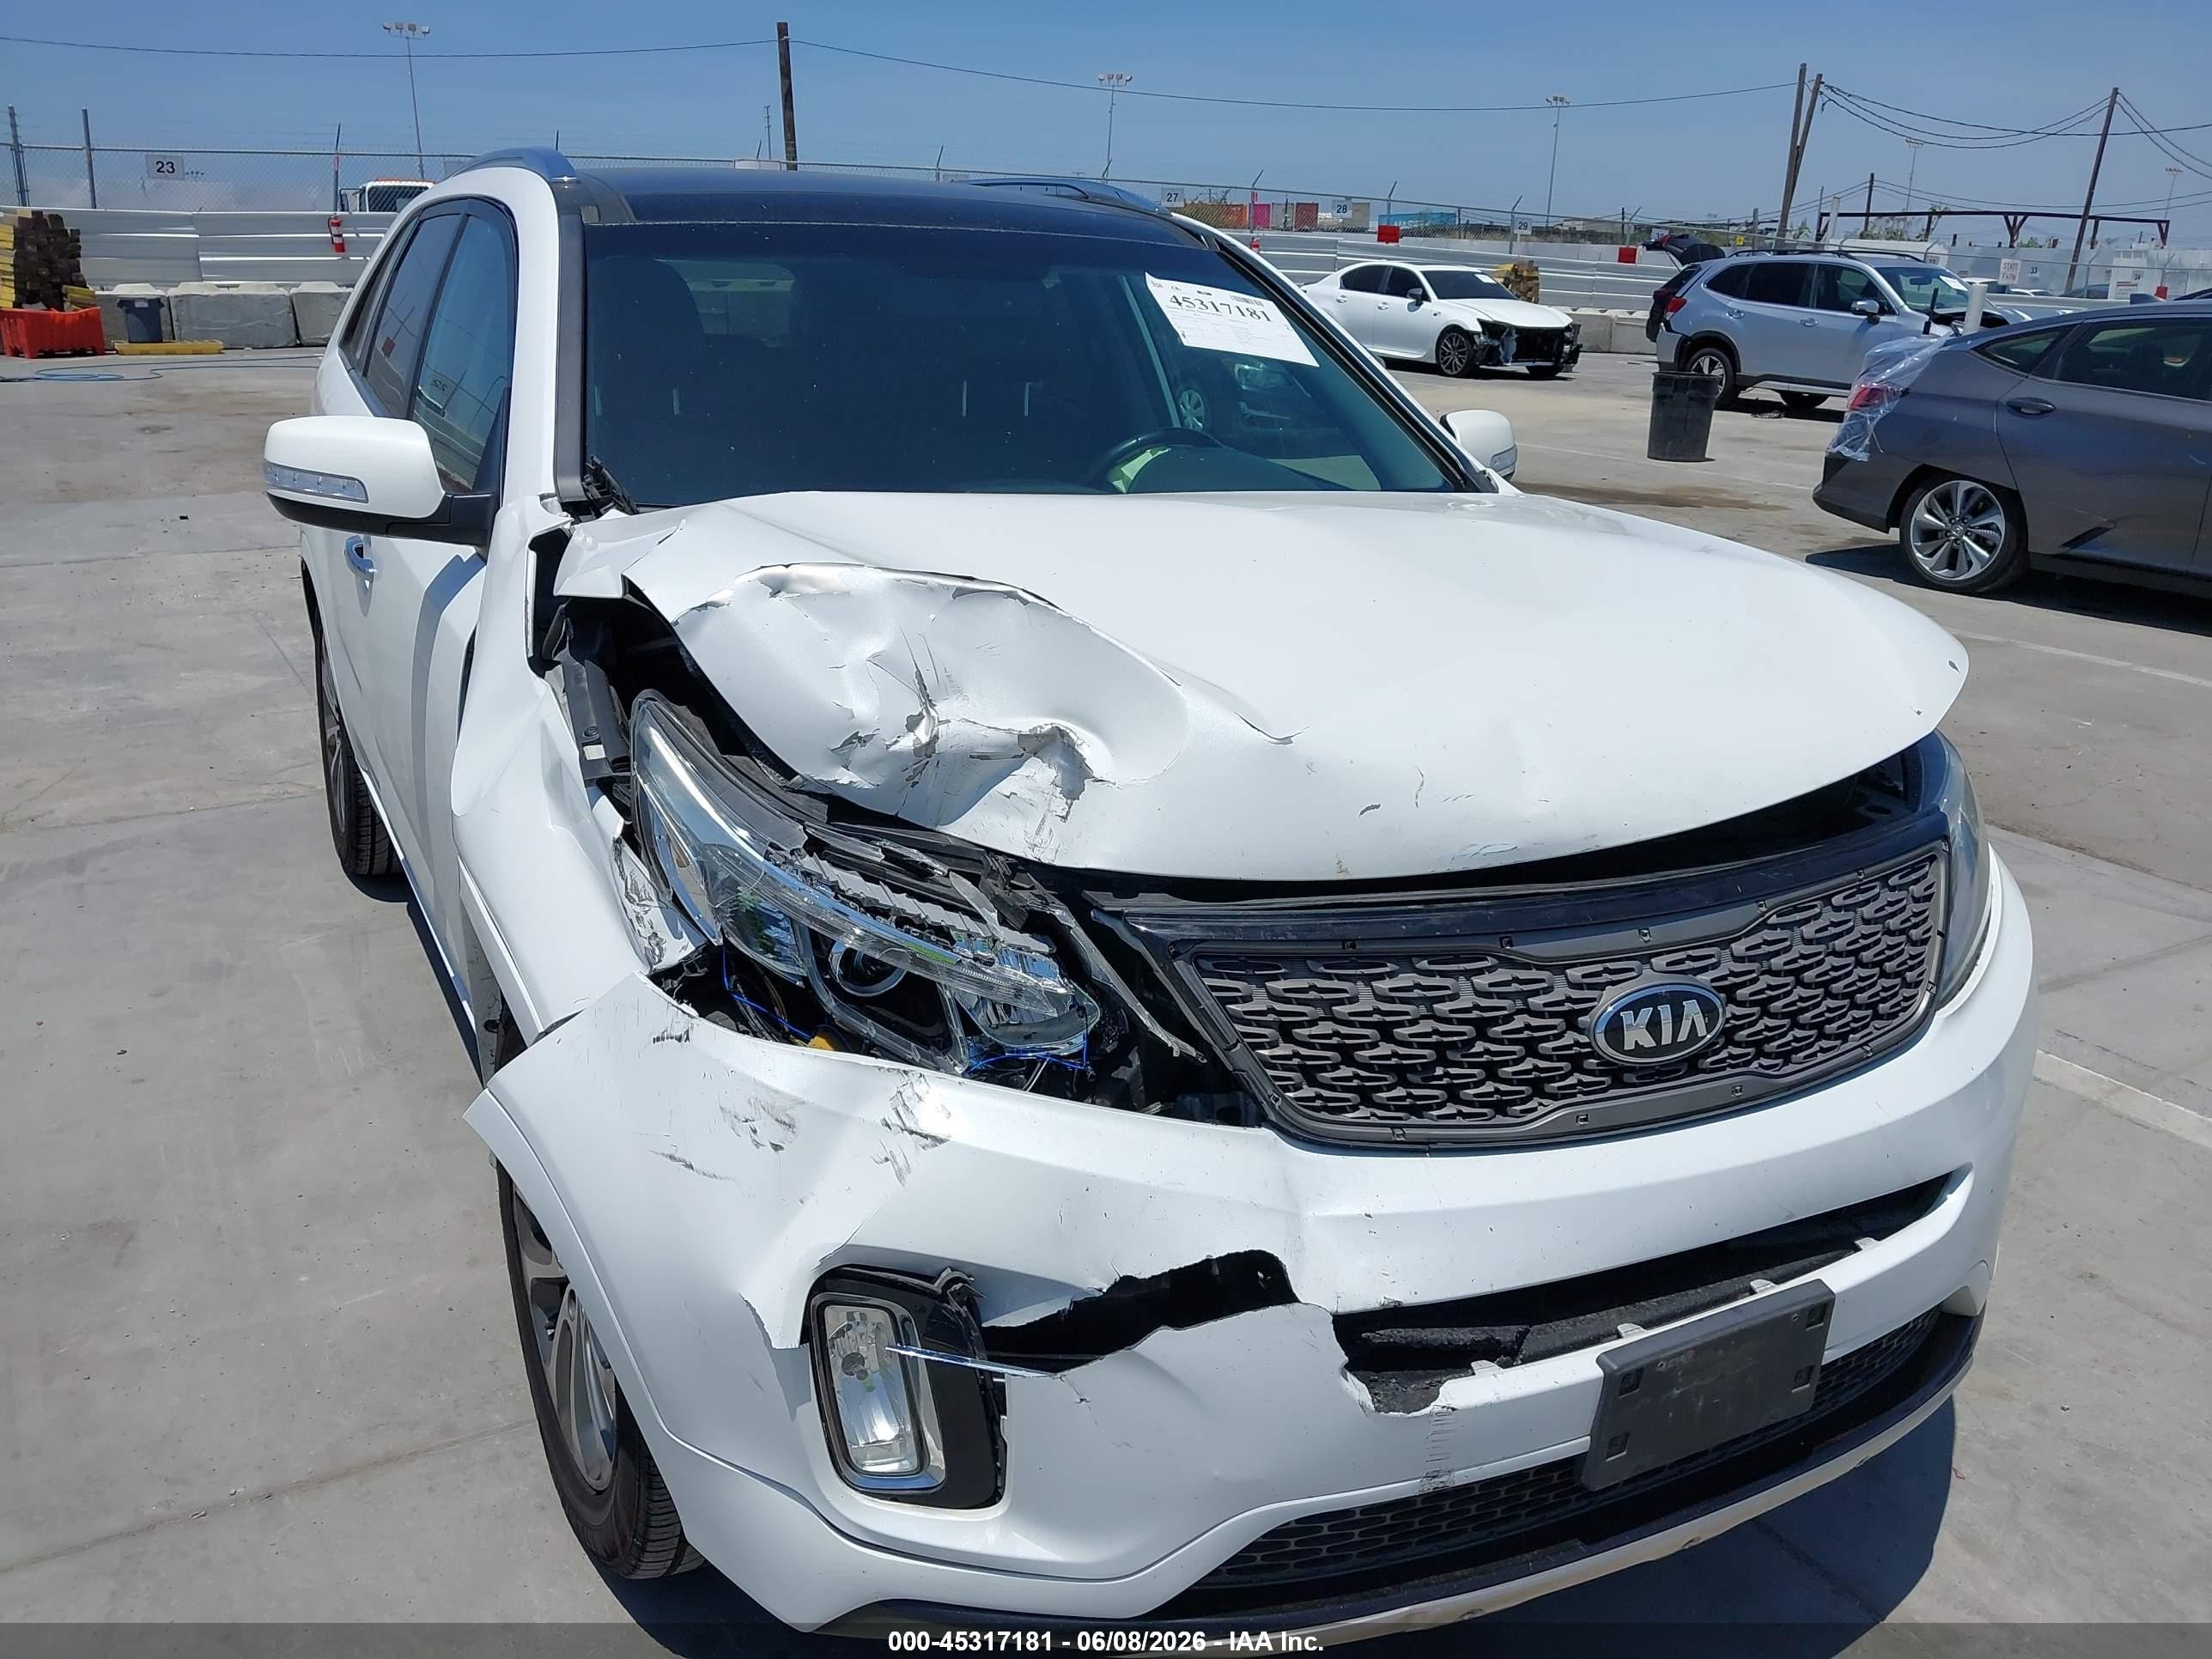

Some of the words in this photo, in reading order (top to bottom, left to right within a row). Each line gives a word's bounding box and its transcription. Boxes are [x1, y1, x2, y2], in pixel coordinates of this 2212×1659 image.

[155, 161, 175, 173] 23
[1167, 192, 1179, 203] 27
[1336, 204, 1347, 214] 28
[1518, 221, 1528, 231] 29
[1170, 295, 1272, 322] 45317181
[1620, 1000, 1707, 1050] KIA
